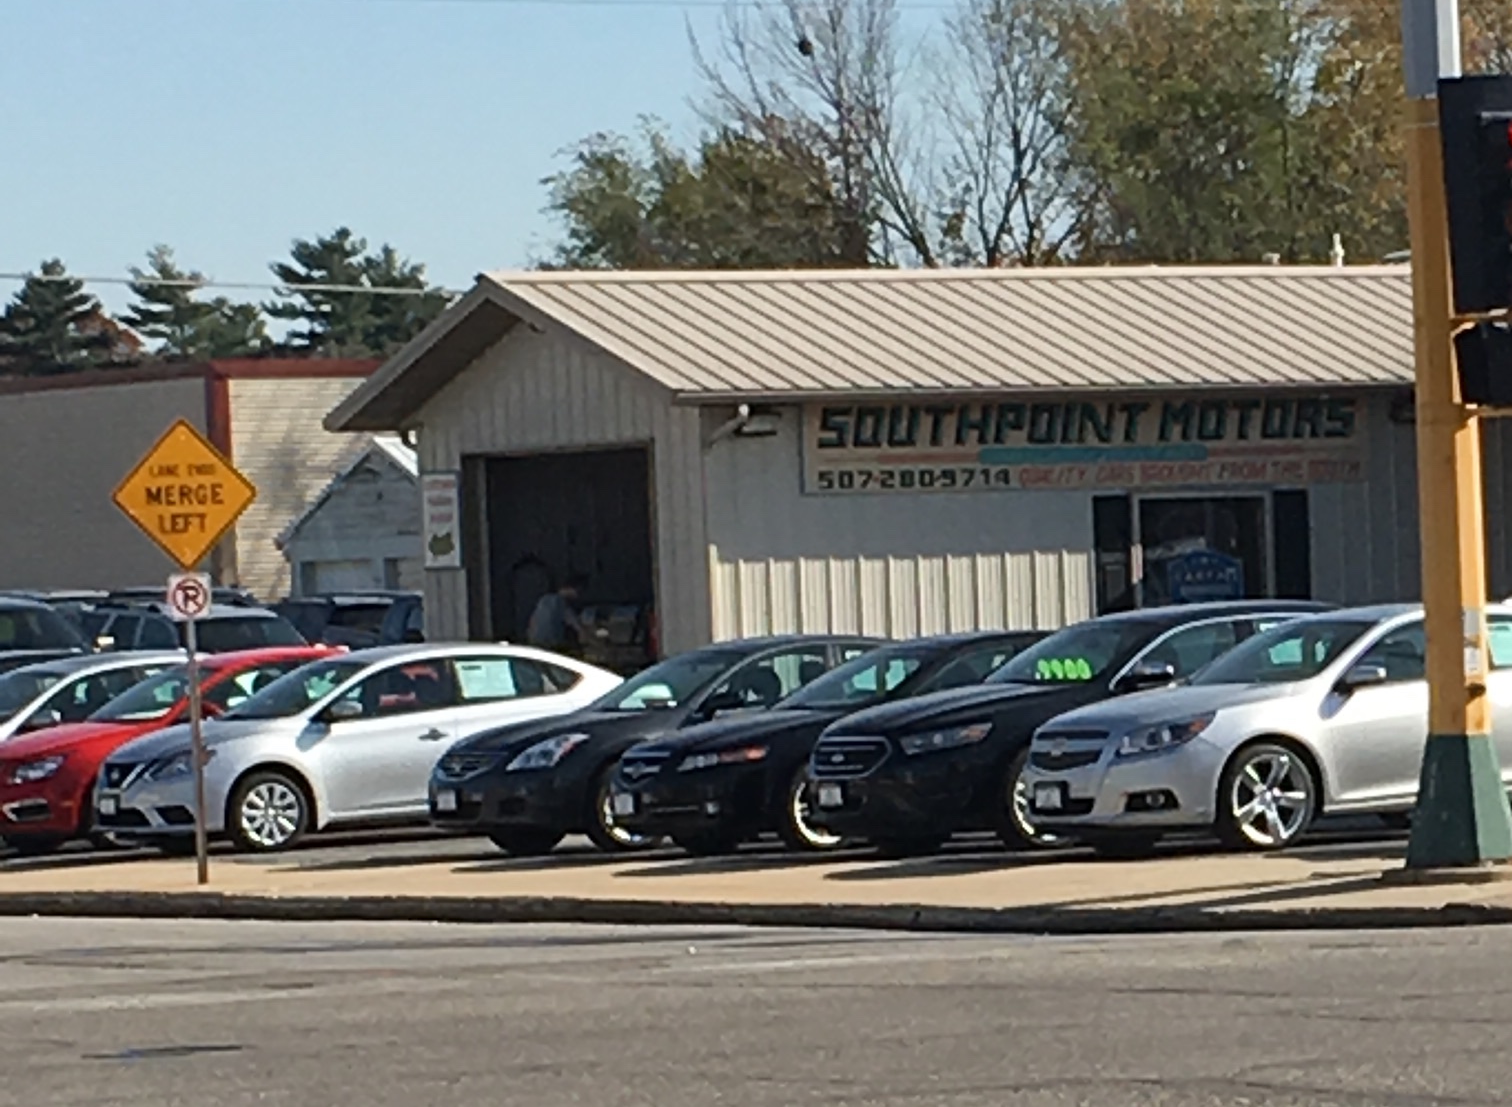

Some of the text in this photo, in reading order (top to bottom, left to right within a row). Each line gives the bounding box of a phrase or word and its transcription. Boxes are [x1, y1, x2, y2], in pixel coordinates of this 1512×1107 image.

[818, 396, 1357, 448] SOUTHPOINT MOTORS
[145, 483, 224, 506] MERGE
[158, 513, 207, 534] LEFT
